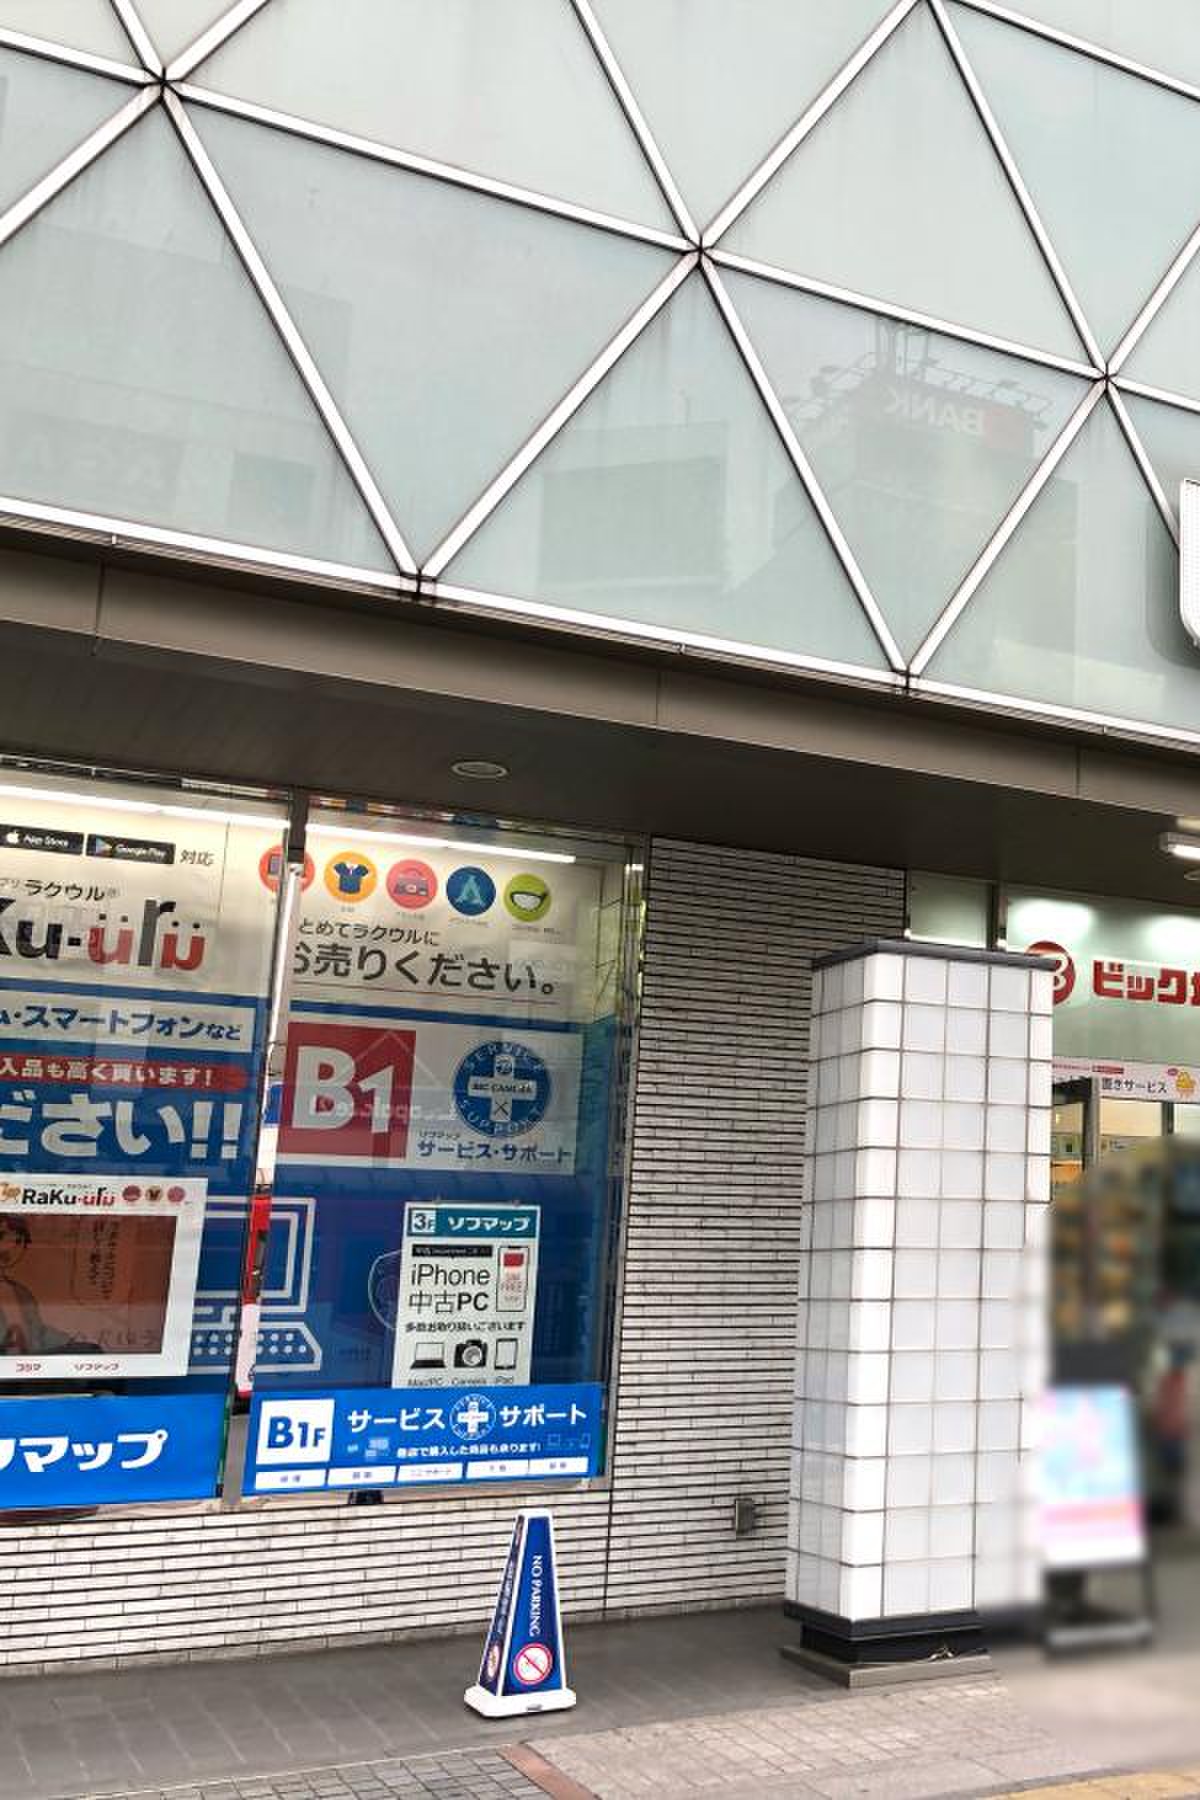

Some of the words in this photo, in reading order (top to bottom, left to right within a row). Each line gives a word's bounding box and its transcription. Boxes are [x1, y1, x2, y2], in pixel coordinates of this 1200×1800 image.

[292, 1046, 395, 1134] B1
[417, 1140, 574, 1164] サービス・サポート
[449, 1217, 531, 1232] ソフマップ
[411, 1263, 491, 1286] iPhone
[408, 1290, 489, 1314] 中古PC
[347, 1408, 446, 1433] サービス
[500, 1403, 587, 1428] サポート
[266, 1415, 326, 1449] B1F
[531, 1555, 543, 1577] NO
[529, 1580, 543, 1637] PARKING
